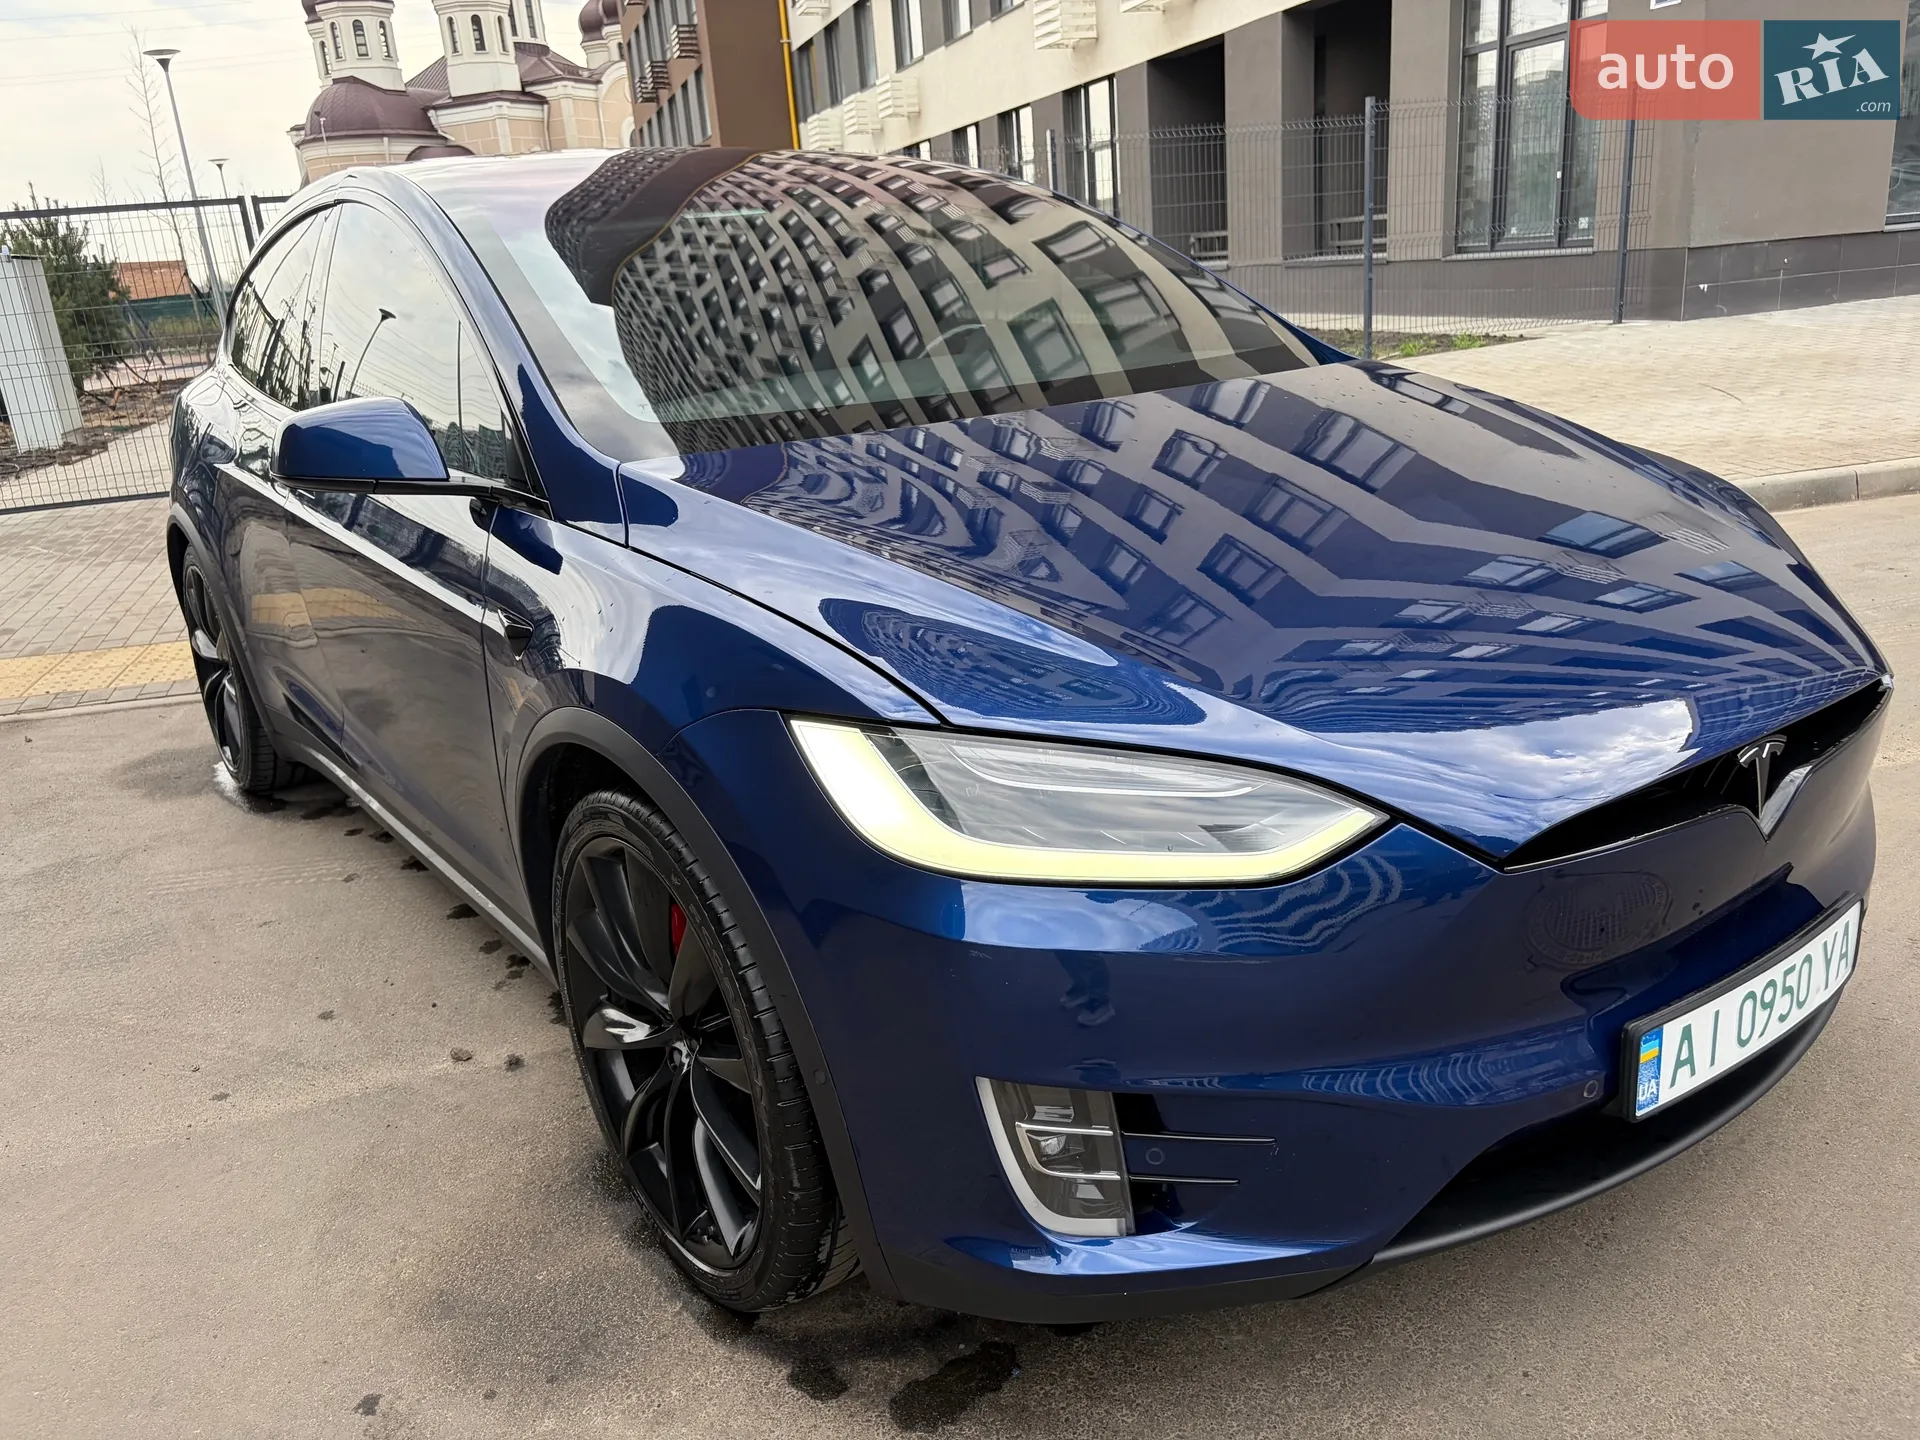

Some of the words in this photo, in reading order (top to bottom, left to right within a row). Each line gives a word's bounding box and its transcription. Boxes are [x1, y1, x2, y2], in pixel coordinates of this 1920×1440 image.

[1669, 1009, 1720, 1089] AI
[1736, 953, 1813, 1048] 0950
[1822, 920, 1850, 991] YA
[1639, 1078, 1658, 1101] UA
